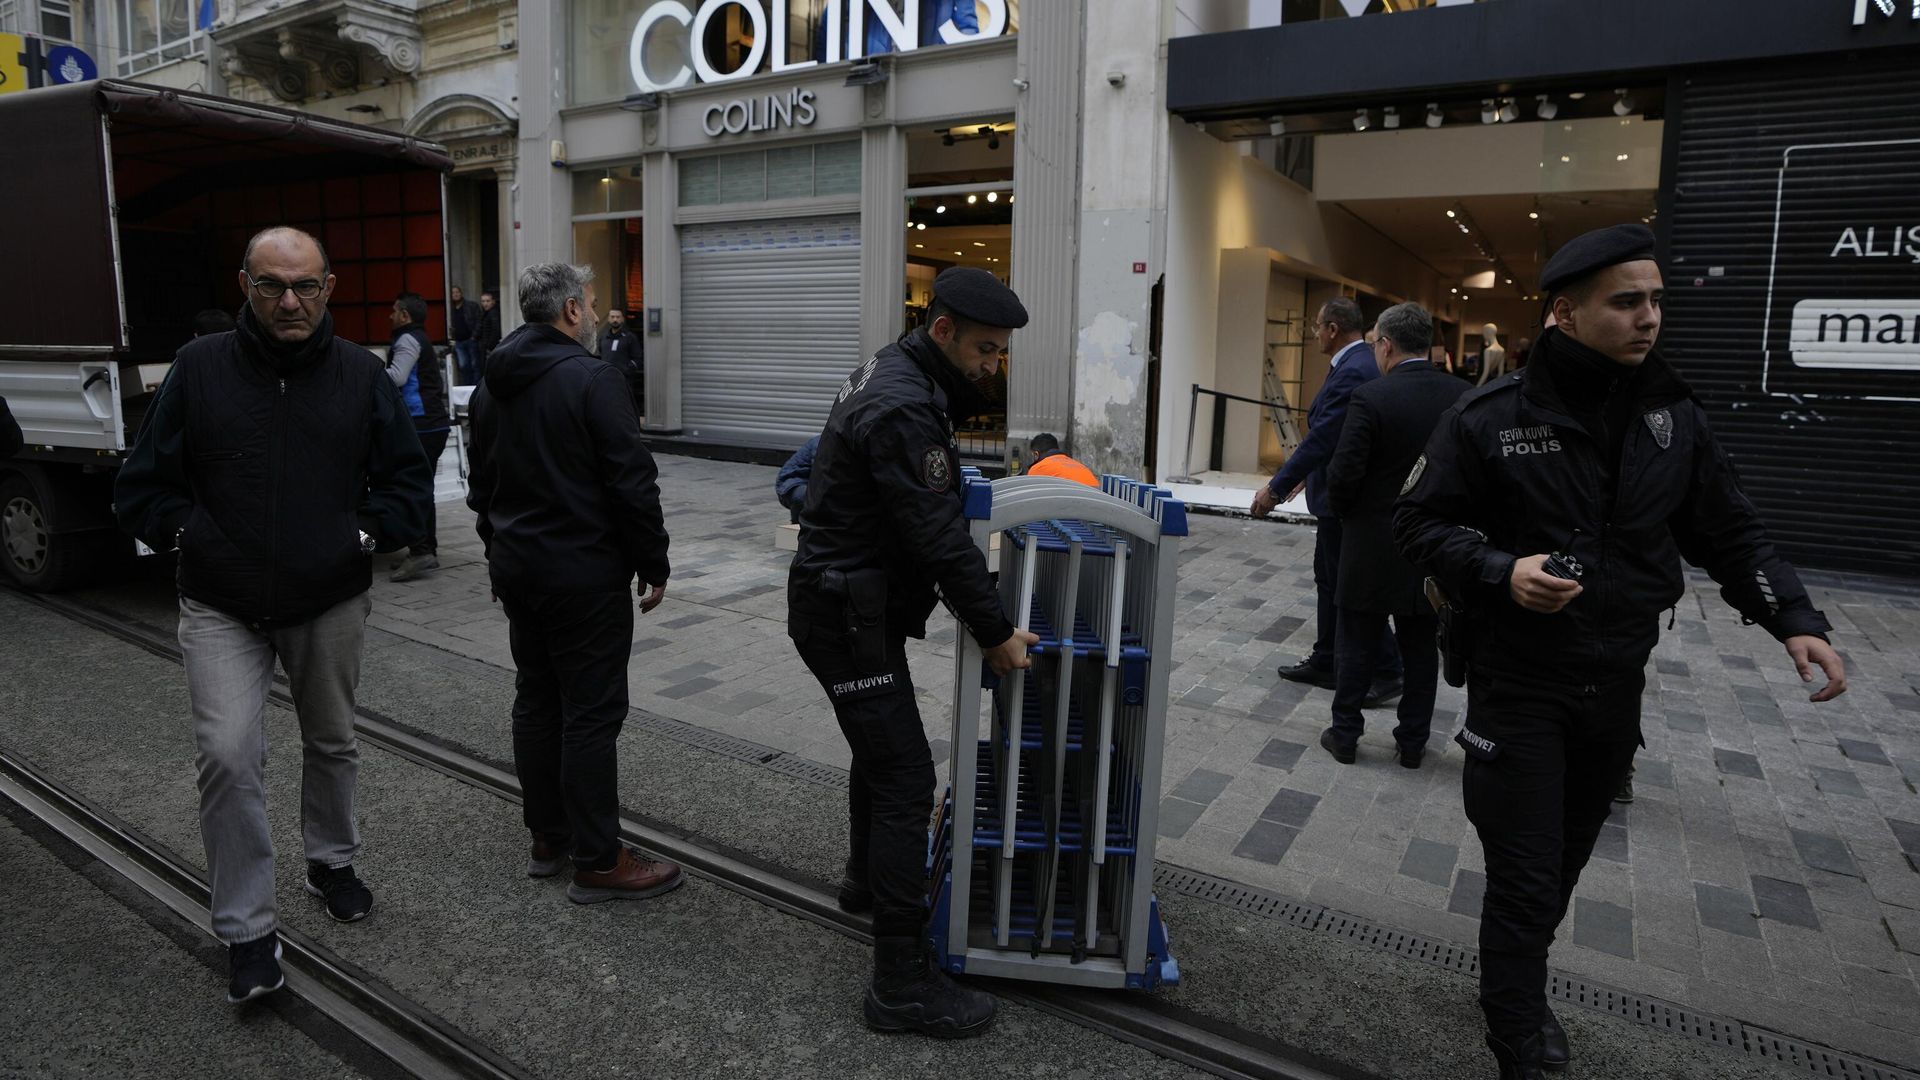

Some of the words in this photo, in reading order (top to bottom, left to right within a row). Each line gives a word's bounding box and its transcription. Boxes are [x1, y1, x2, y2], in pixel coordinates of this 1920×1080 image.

[702, 87, 818, 137] COLIN'S
[1818, 313, 1920, 344] ma
[1499, 428, 1525, 445] ÇEVİK
[1525, 424, 1555, 440] KUVVE
[1502, 440, 1562, 457] POLİS
[833, 680, 857, 697] ÇEVİK
[857, 673, 895, 690] KUVVET
